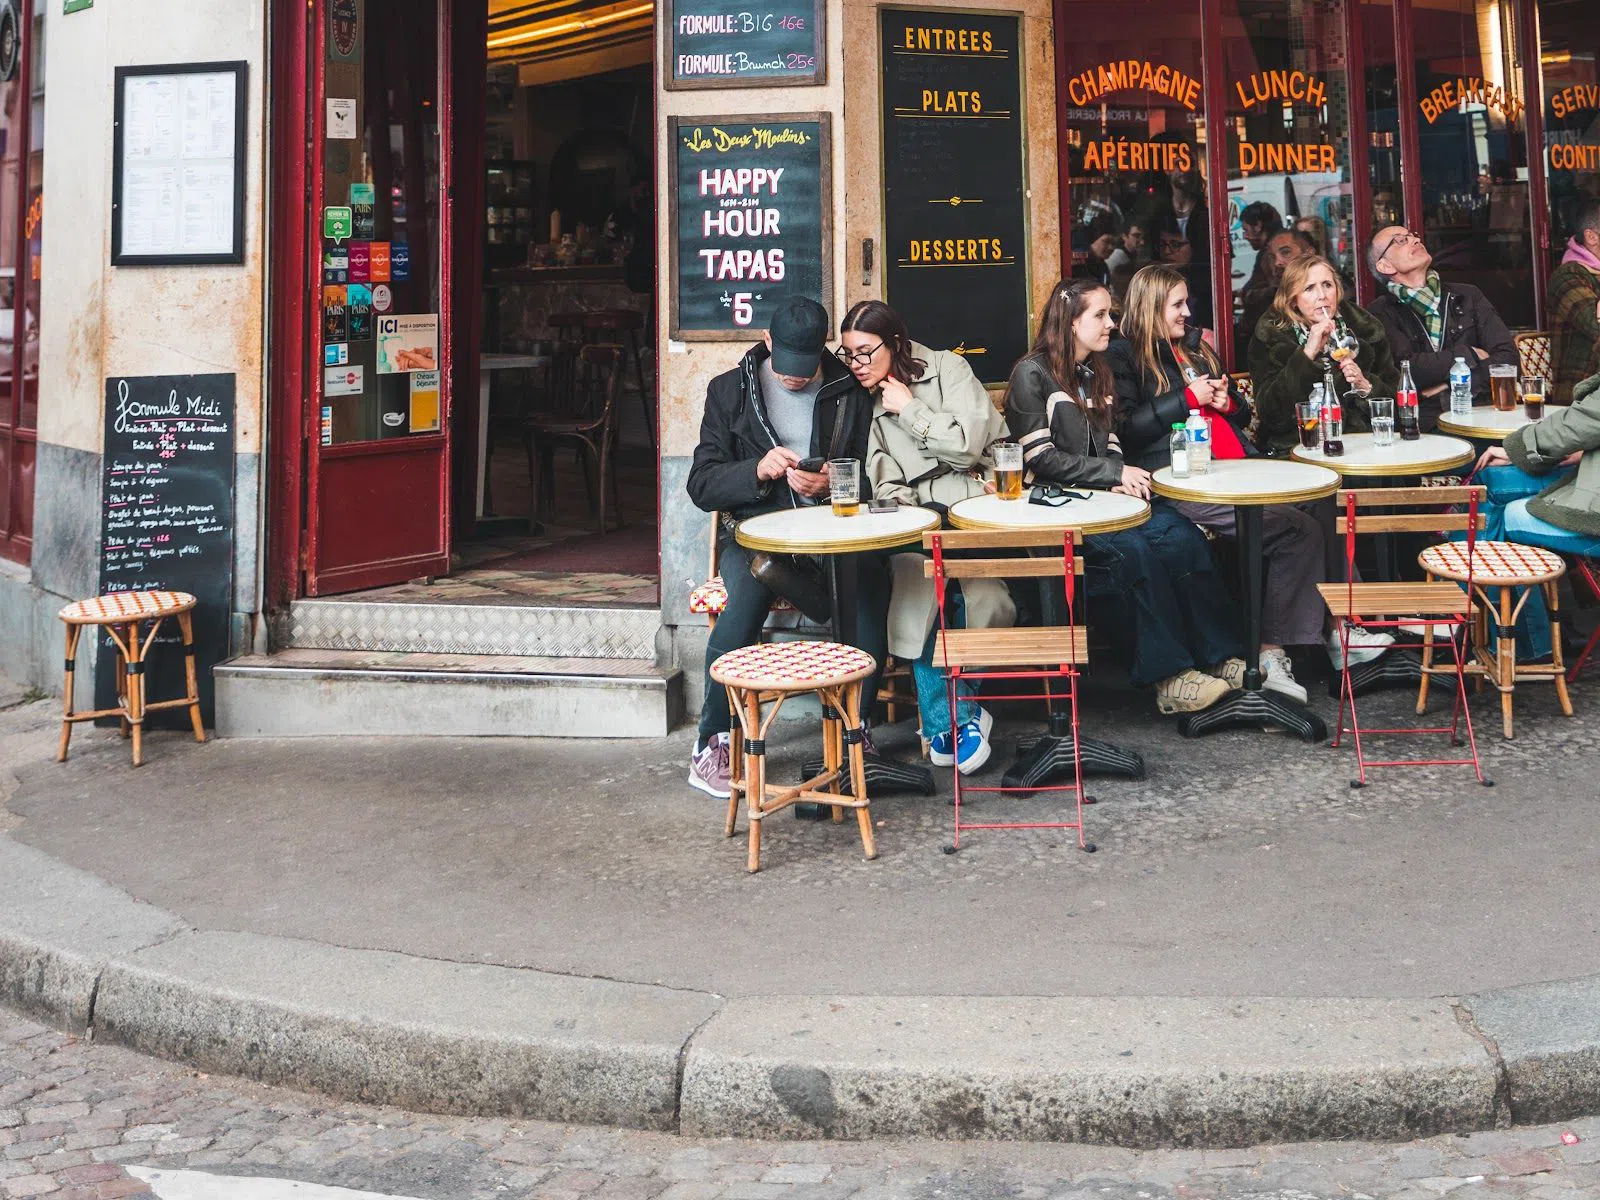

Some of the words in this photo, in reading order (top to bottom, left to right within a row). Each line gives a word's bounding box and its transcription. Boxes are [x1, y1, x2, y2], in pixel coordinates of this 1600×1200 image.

[739, 12, 774, 33] BIG
[736, 51, 786, 71] Brunch
[1068, 60, 1203, 110] CHAMPAGNE
[1235, 69, 1326, 109] LUNCH
[921, 90, 982, 113] PLATS
[1419, 77, 1525, 124] BREAKFAST
[1551, 84, 1600, 119] SERV
[713, 127, 752, 152] Deux
[752, 127, 805, 150] Moulins
[1084, 136, 1192, 173] APÉRITIFS
[1239, 142, 1337, 174] DINNER
[1551, 143, 1600, 169] CONT
[699, 168, 785, 196] HAPPY
[702, 208, 781, 239] HOUR
[909, 238, 1003, 261] DESSERTS
[699, 248, 785, 282] TAPAS
[733, 292, 753, 326] 5
[380, 319, 398, 334] ICI
[186, 395, 221, 416] Midi
